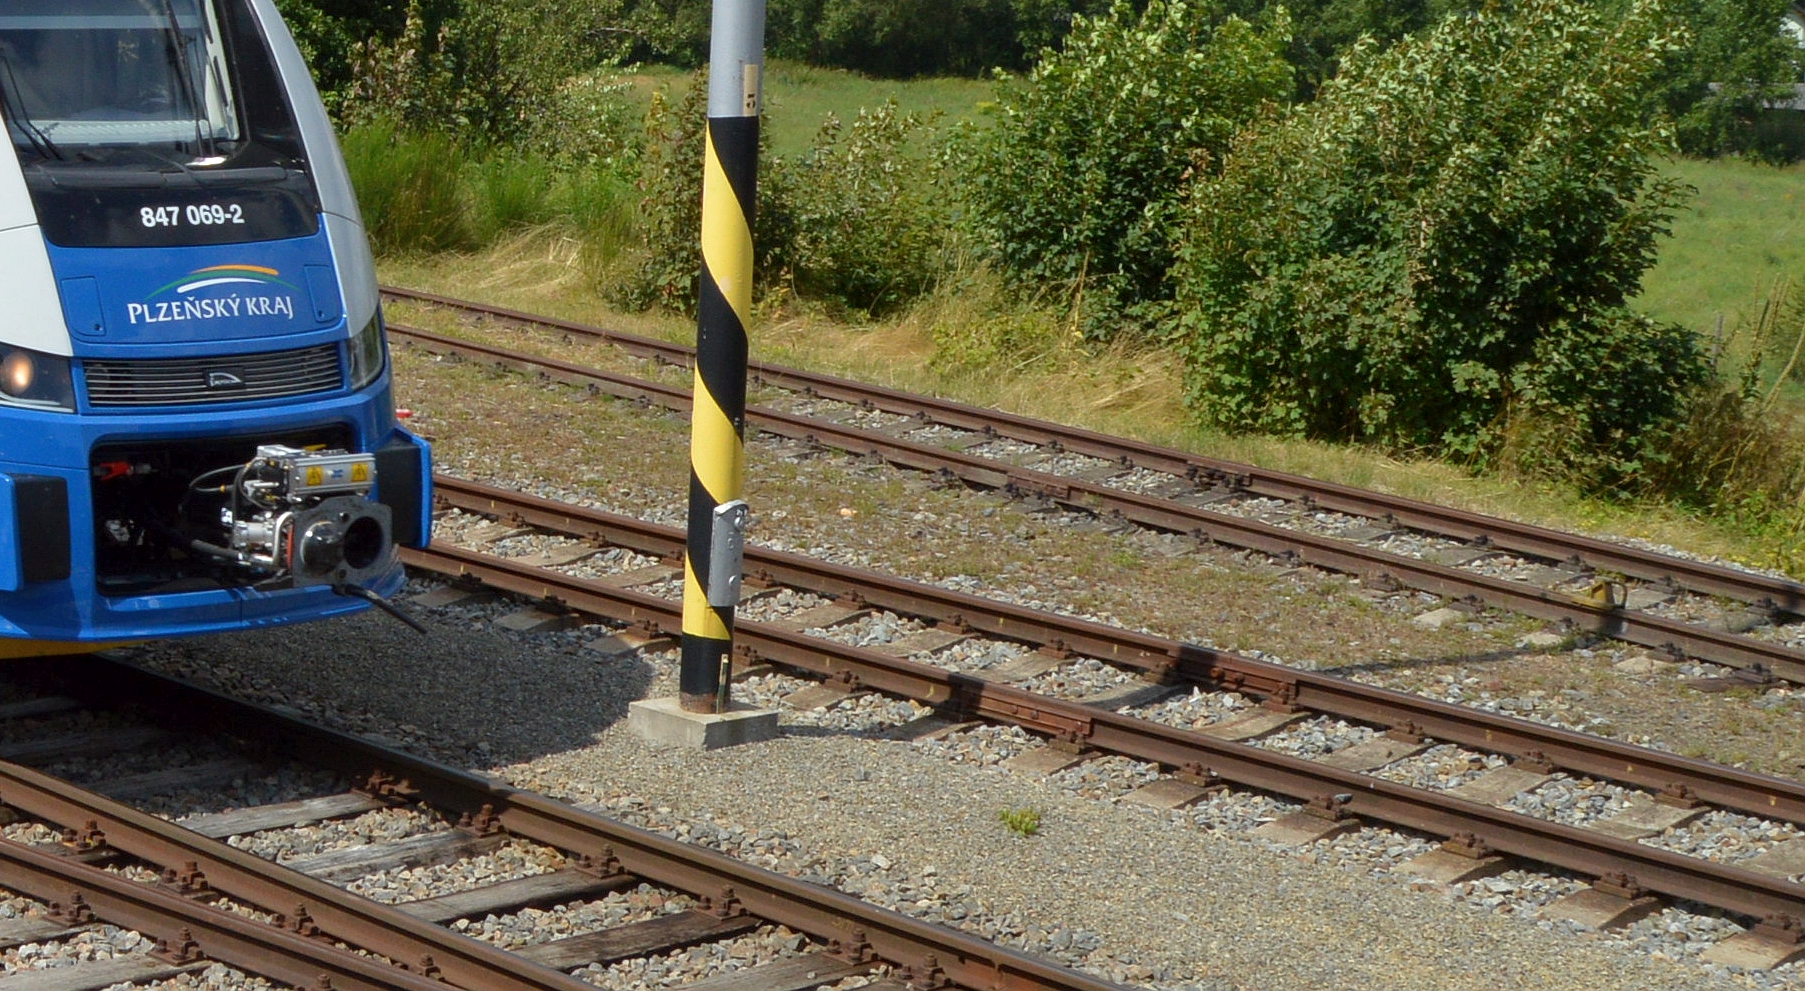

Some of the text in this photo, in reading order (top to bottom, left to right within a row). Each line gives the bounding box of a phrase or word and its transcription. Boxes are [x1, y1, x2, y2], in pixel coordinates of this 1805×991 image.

[140, 204, 245, 227] 847 069-2
[127, 293, 294, 324] PLZEŇSKÝ KRAJ
